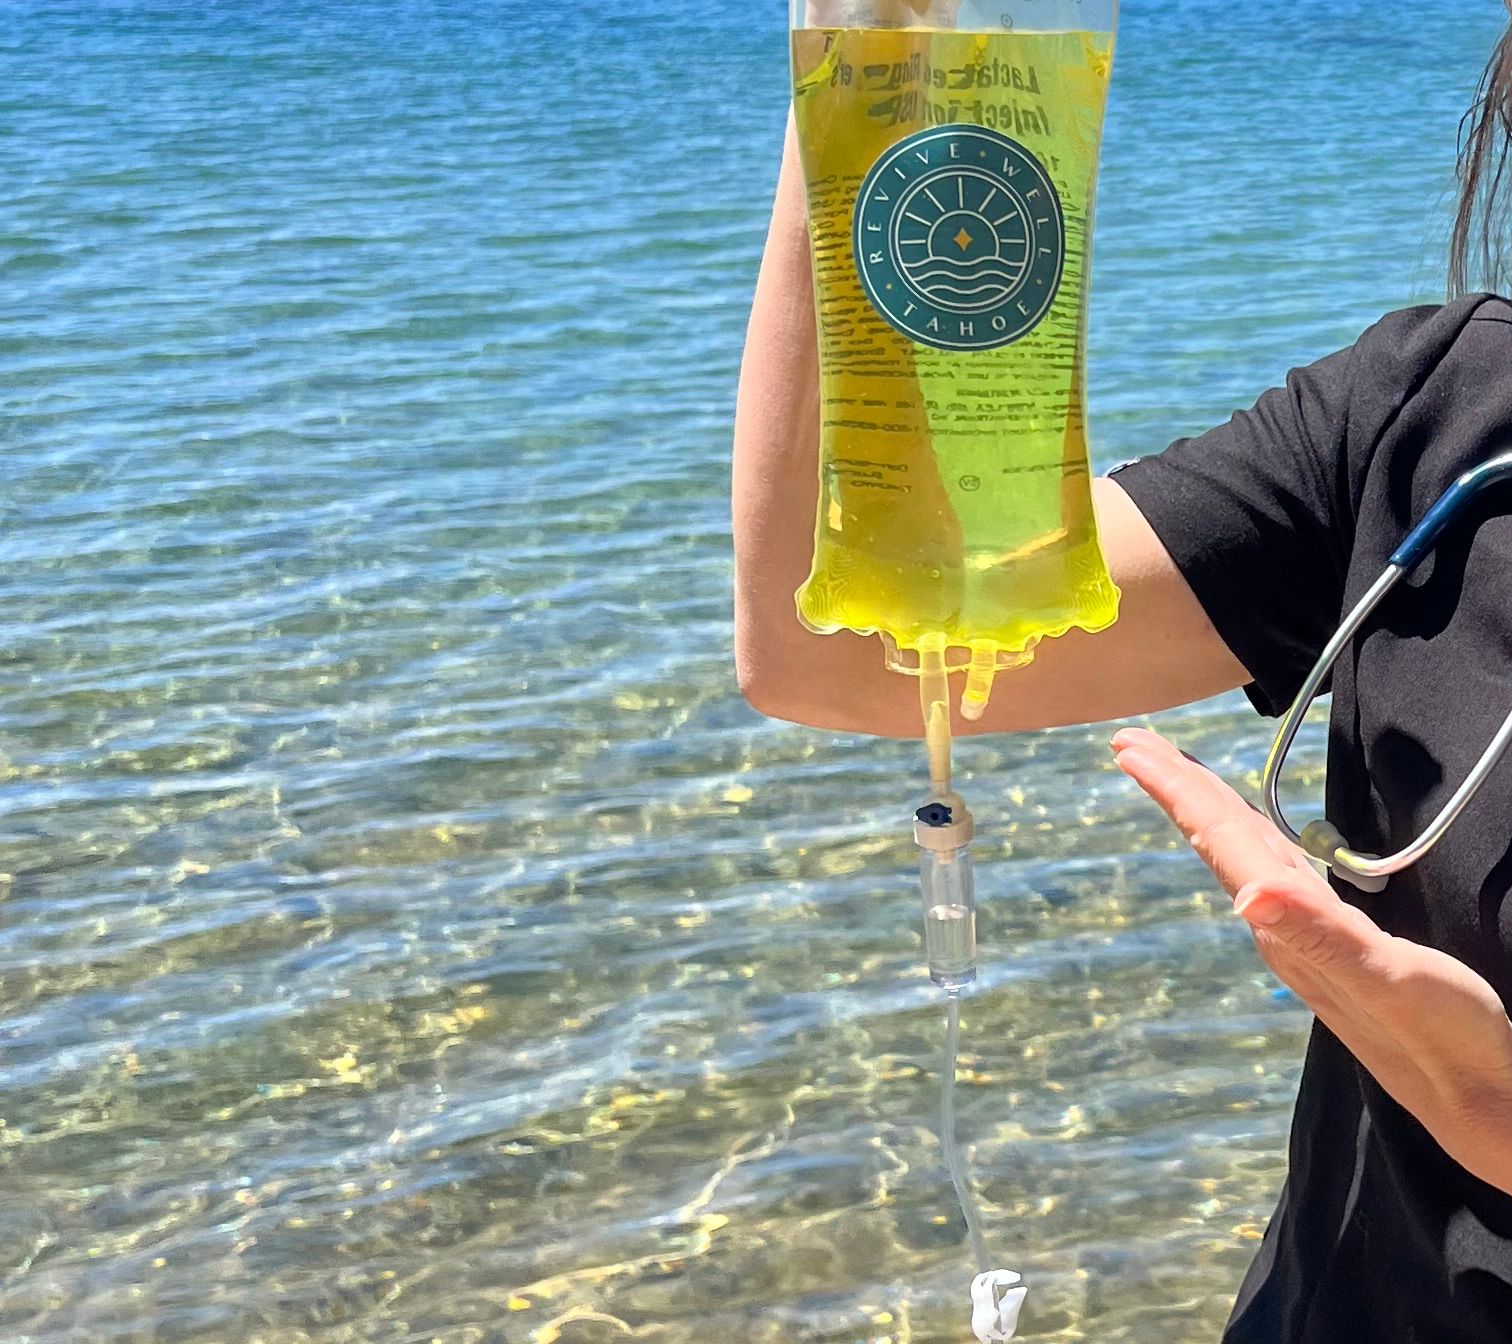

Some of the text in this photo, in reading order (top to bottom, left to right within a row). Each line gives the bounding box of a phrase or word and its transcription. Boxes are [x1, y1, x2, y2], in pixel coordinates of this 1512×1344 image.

[867, 142, 960, 264] REVIVE
[1001, 157, 1052, 258] WELL
[903, 300, 1031, 337] TAHOE
